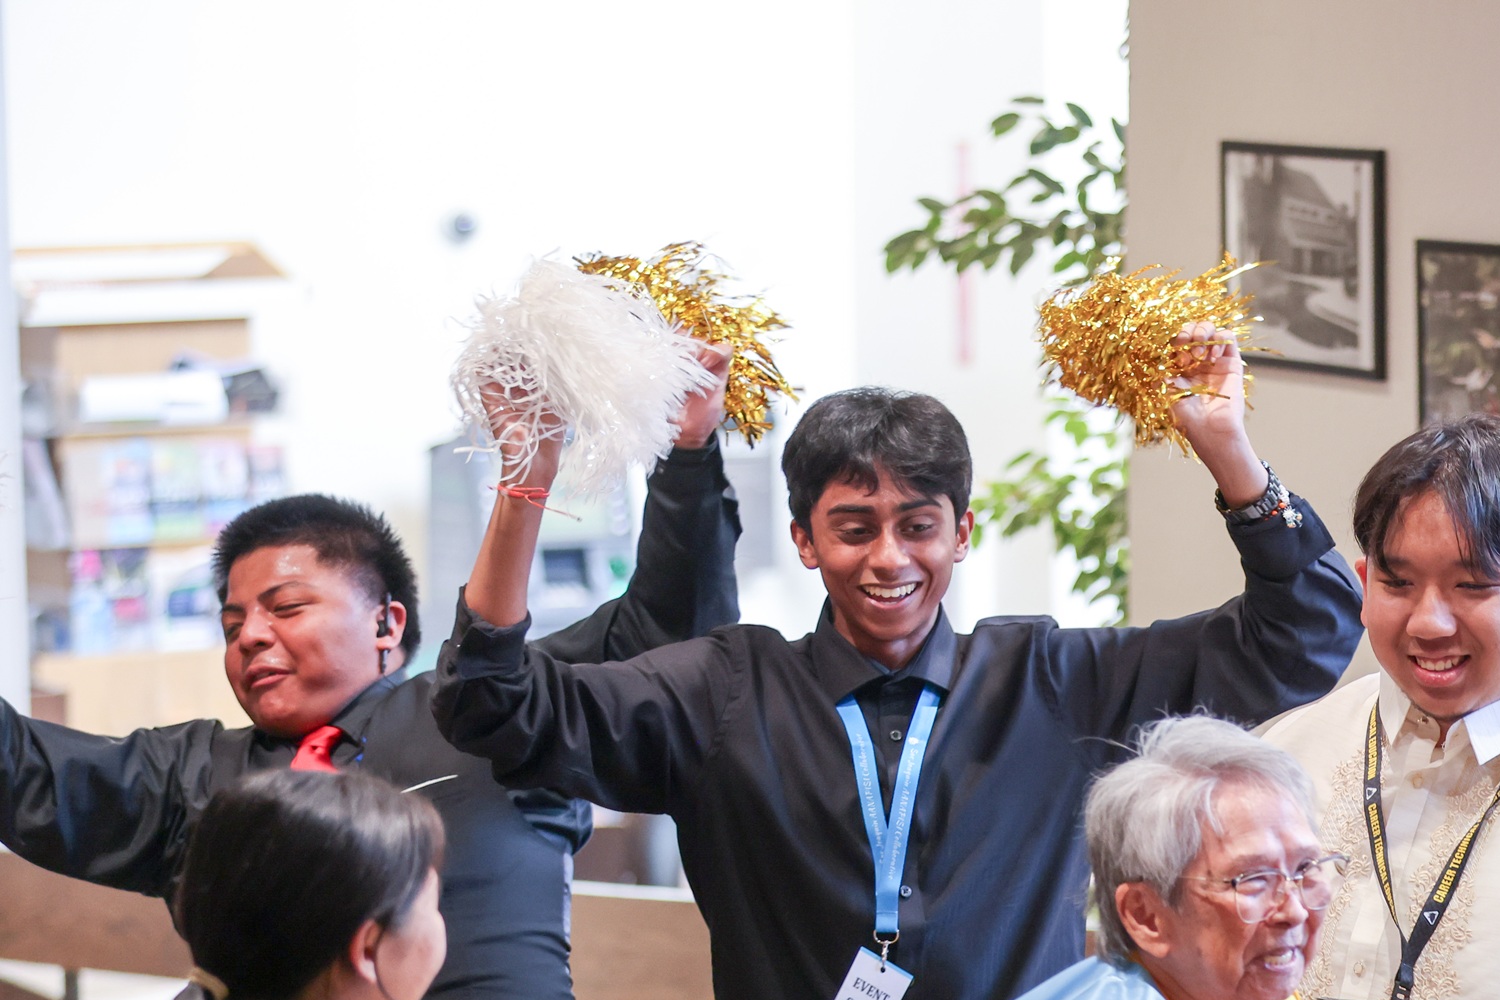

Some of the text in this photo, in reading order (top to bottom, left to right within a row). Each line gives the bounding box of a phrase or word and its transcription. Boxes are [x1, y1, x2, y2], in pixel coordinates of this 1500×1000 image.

[1367, 736, 1378, 780] EDUCATION
[1367, 802, 1389, 887] CAREER TECHNICAL
[1433, 868, 1457, 904] CAREER
